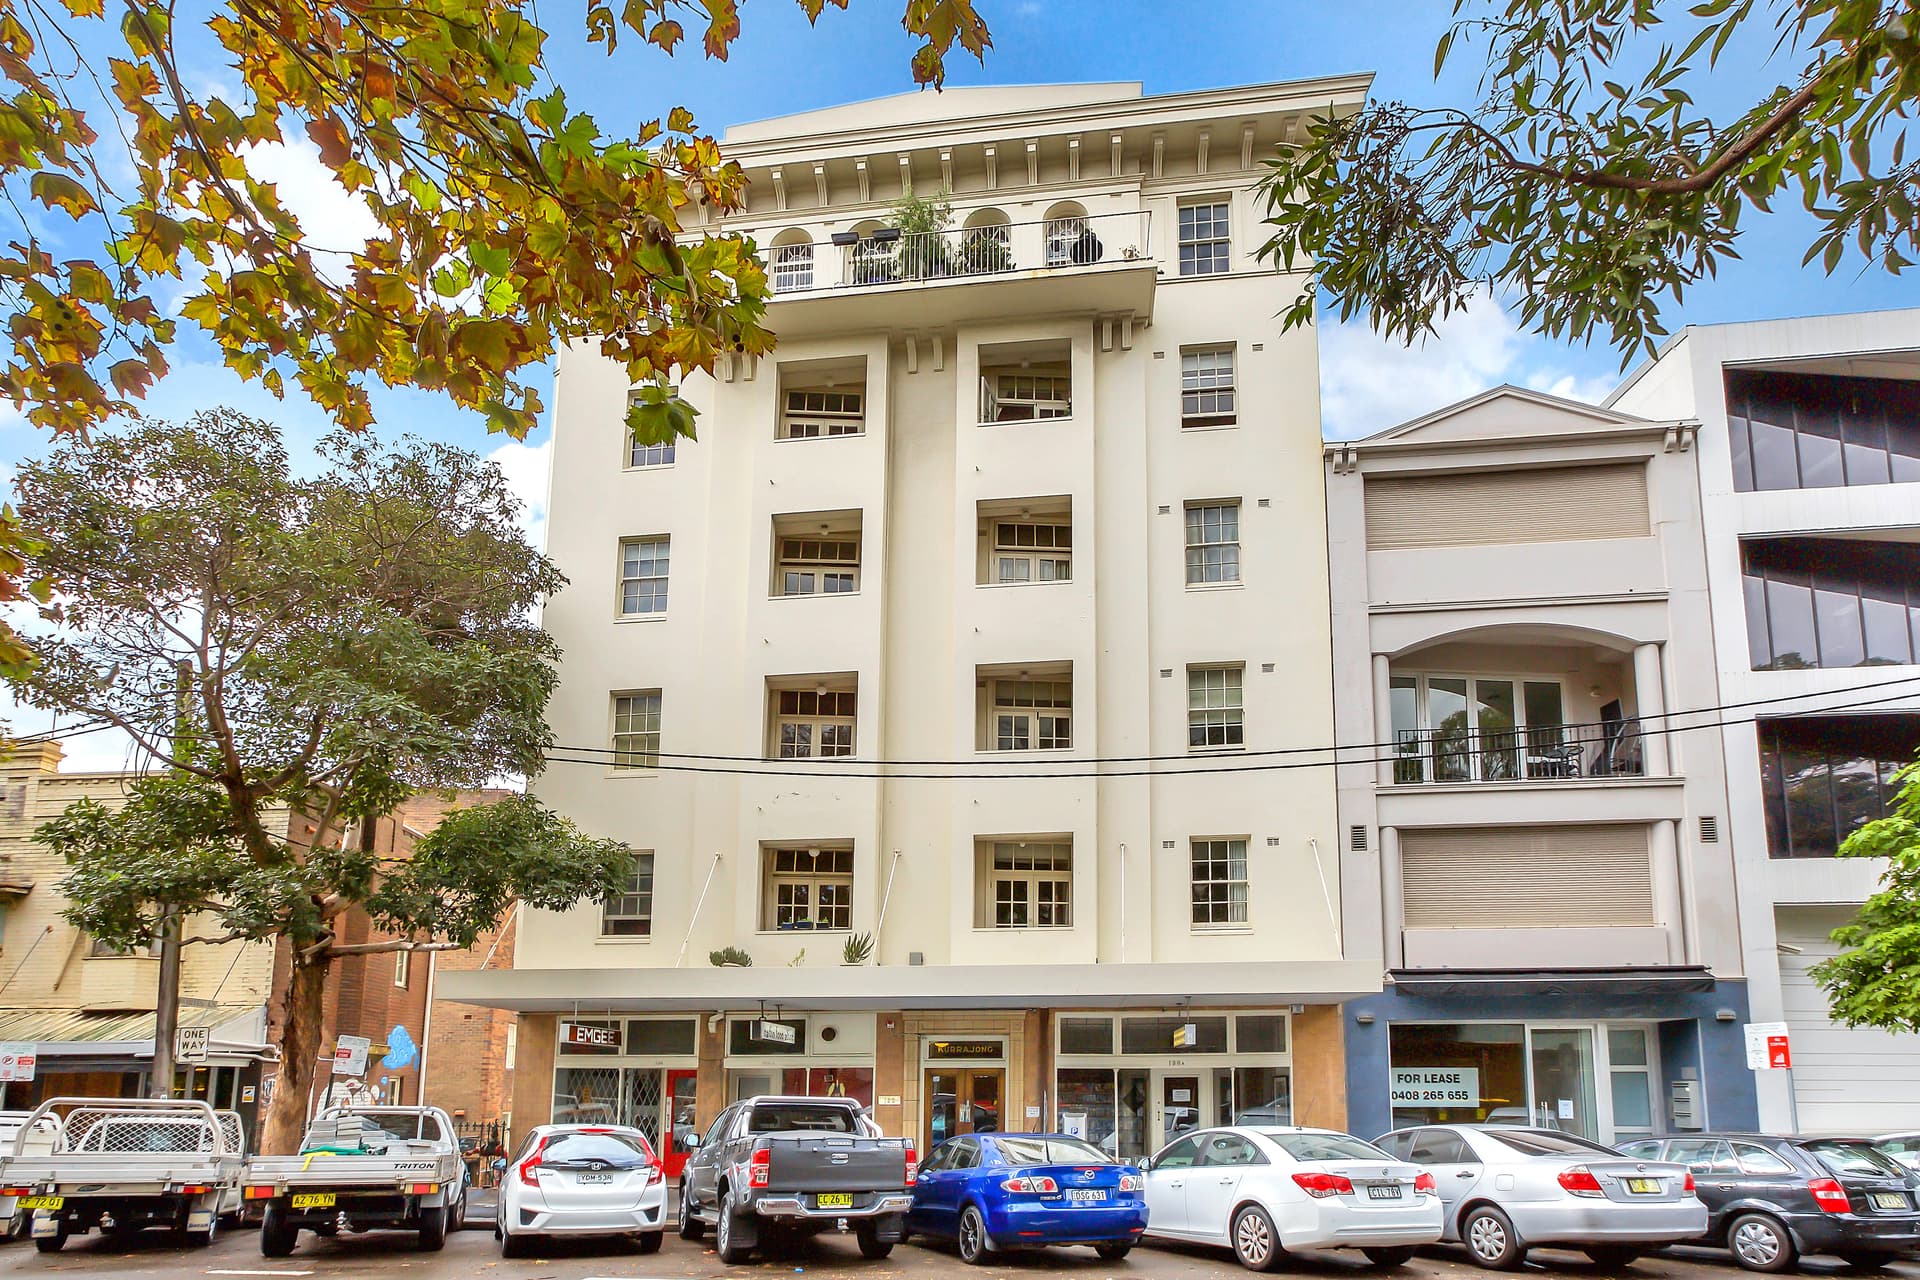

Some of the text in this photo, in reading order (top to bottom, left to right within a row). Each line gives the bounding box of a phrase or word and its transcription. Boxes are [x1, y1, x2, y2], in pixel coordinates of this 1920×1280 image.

[184, 1030, 205, 1039] ONE
[577, 1027, 615, 1044] EMGEE
[182, 1041, 205, 1050] WAY
[937, 1045, 993, 1054] KURRAJONG
[1397, 1074, 1461, 1084] FOR LEASE
[1392, 1091, 1469, 1100] 0408 265 655
